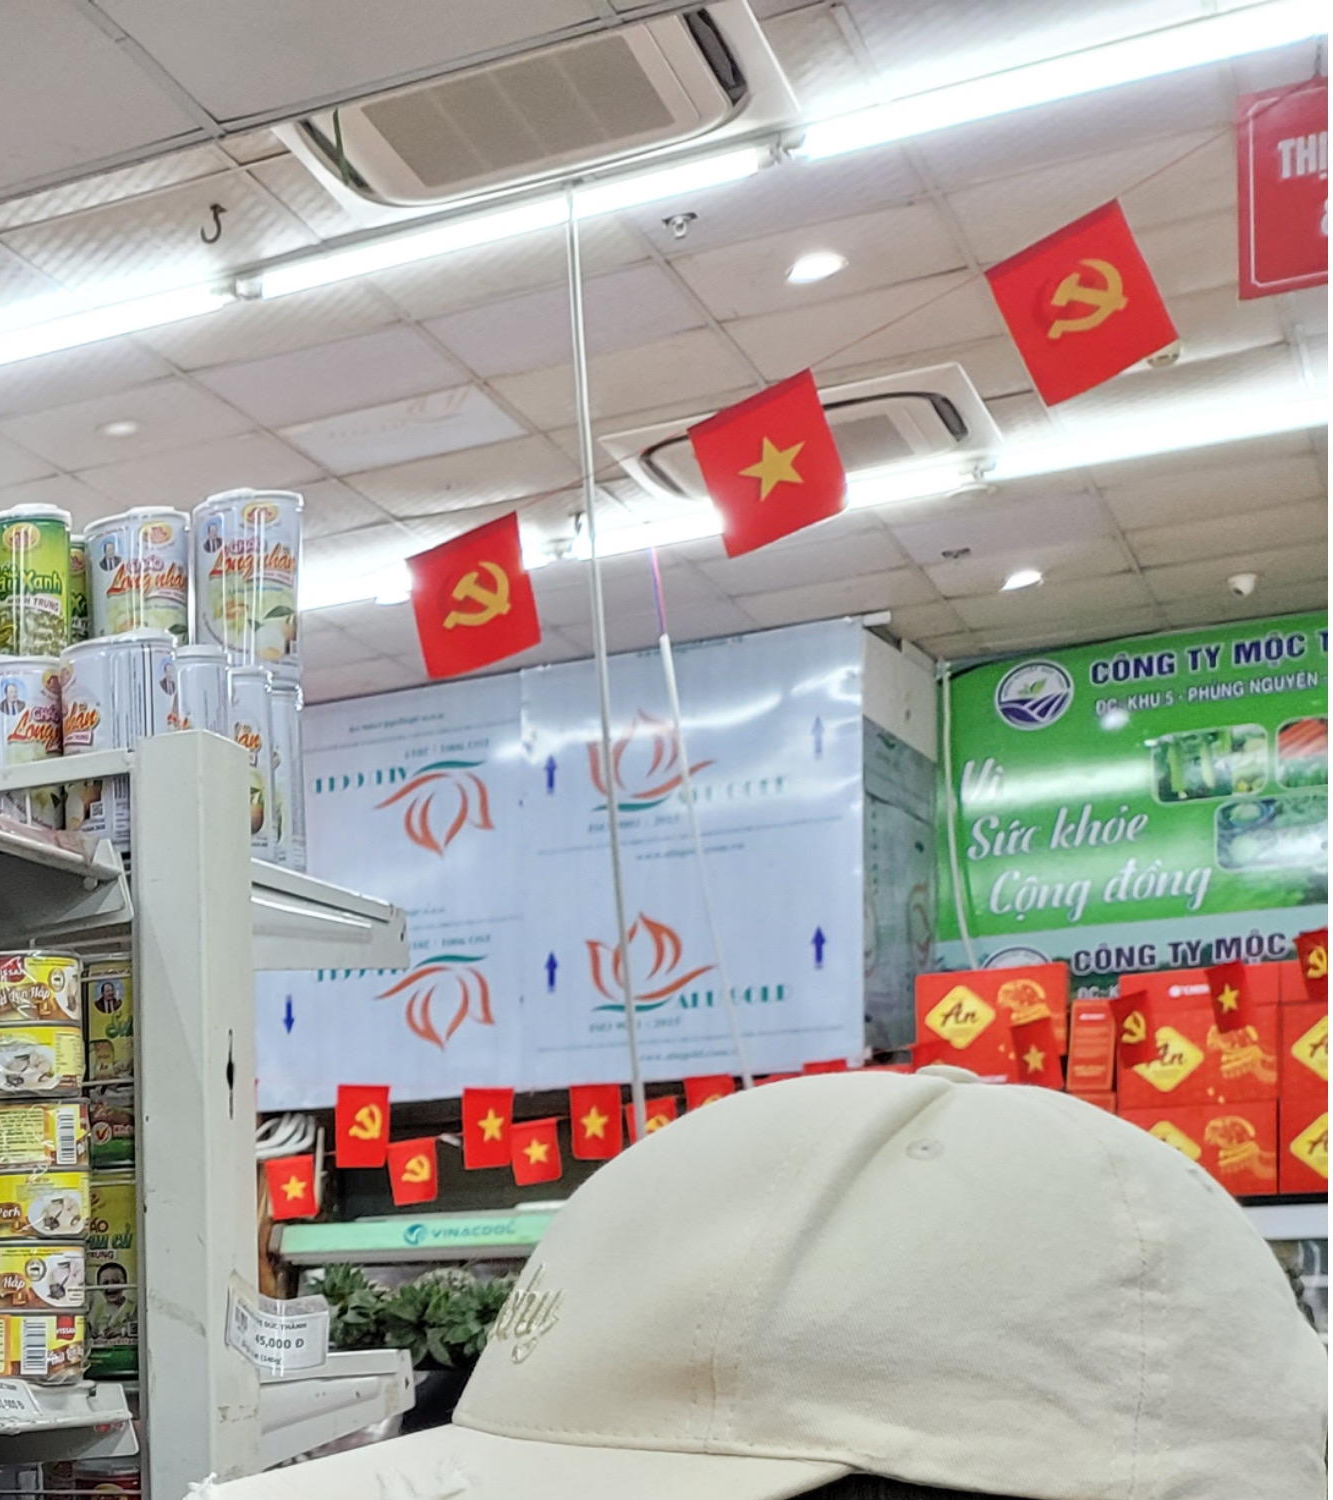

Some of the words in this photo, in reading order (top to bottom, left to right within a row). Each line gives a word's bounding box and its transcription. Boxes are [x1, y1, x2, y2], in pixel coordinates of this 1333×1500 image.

[23, 570, 62, 595] Xanh
[1091, 652, 1176, 685] CÔNG
[1187, 646, 1220, 672] TY
[1233, 633, 1306, 666] MỘC
[1128, 692, 1160, 711] KHU
[1165, 690, 1174, 705] 5
[961, 758, 1004, 800] Vì
[967, 814, 1041, 861] Sức
[1049, 806, 1149, 851] khỏe
[990, 869, 1090, 922] Cộng
[1103, 860, 1212, 910] đồng
